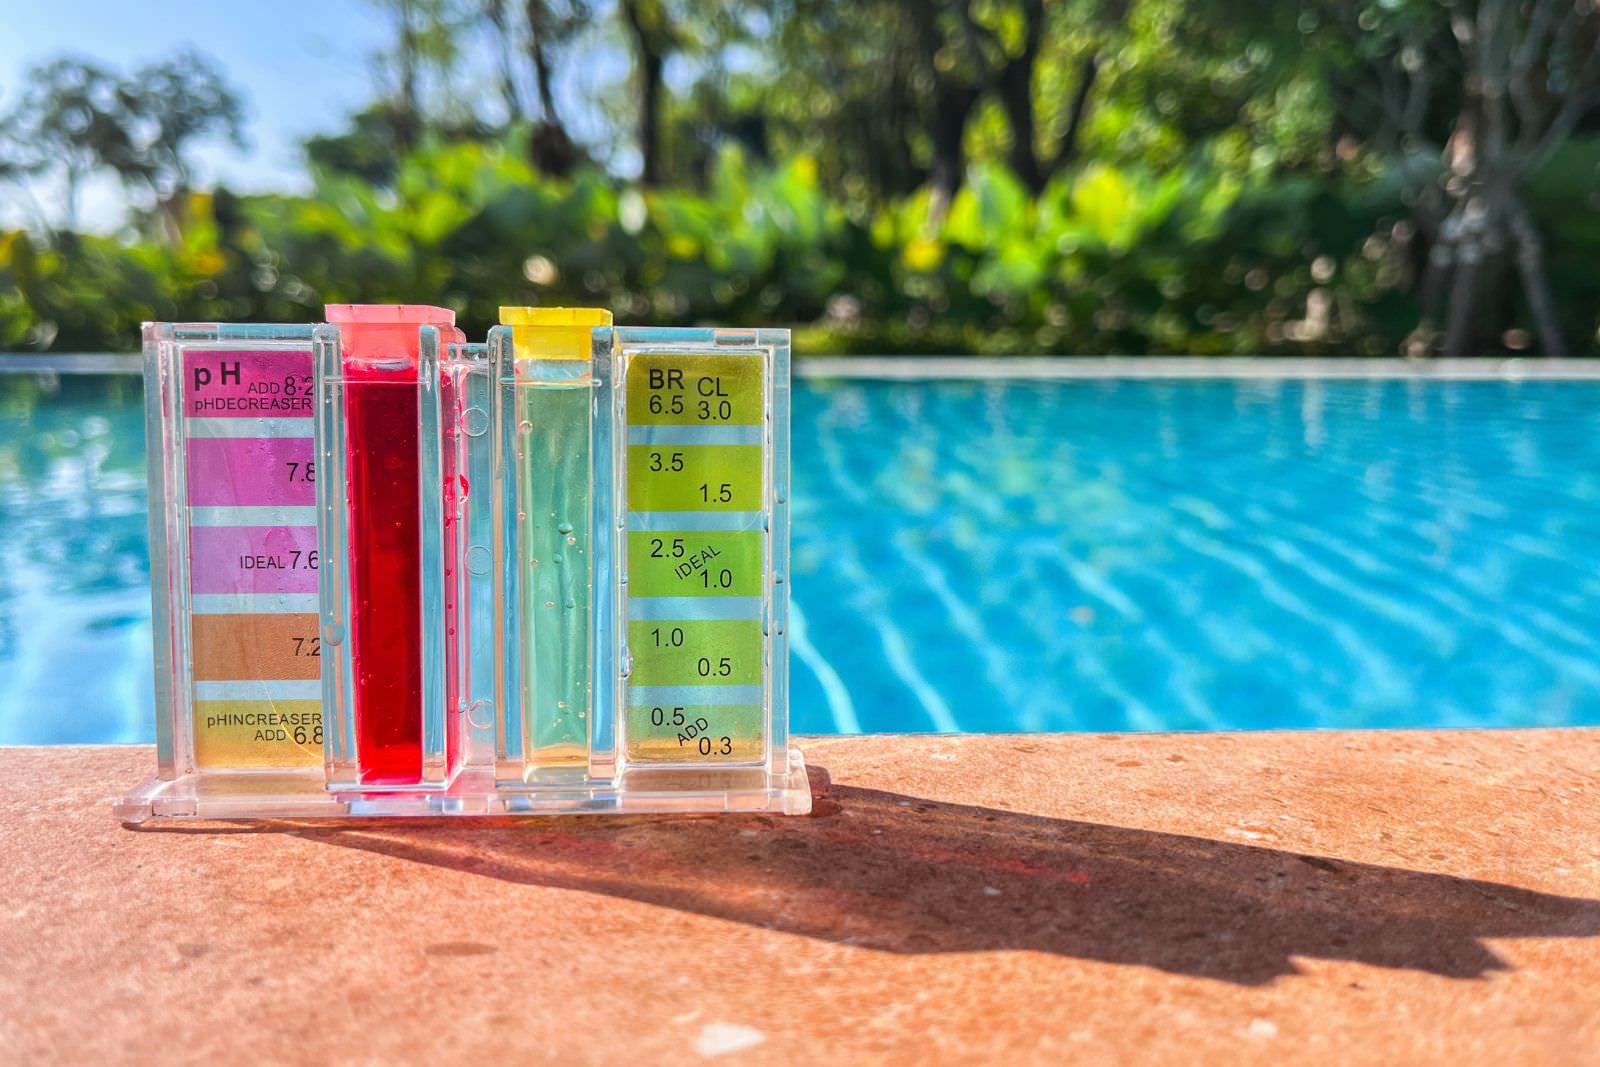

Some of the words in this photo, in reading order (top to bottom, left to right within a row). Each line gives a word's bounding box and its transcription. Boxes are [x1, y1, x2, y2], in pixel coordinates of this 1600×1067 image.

[248, 383, 280, 394] ADD
[650, 369, 685, 390] BR
[697, 377, 729, 397] CL
[195, 398, 312, 412] pHDECREASER
[650, 395, 684, 415] 6.5
[698, 401, 731, 420] 3.0
[650, 453, 684, 472] 3.5
[286, 463, 315, 482] 7.8
[700, 484, 732, 503] 1.5
[651, 539, 685, 558] 2.5
[241, 556, 285, 569] IDEAL
[289, 551, 318, 570] 7.6
[674, 545, 721, 580] IDEAL
[700, 569, 732, 588] 1.0
[292, 638, 320, 656] 7.2
[651, 628, 684, 647] 1.0
[698, 658, 731, 676] 0.5
[207, 714, 322, 728] pHINCREASER
[651, 708, 685, 726] 0.5
[254, 730, 286, 741] ADD
[294, 726, 323, 744] 6.8
[677, 718, 708, 746] ADD
[699, 736, 732, 755] 0.3
